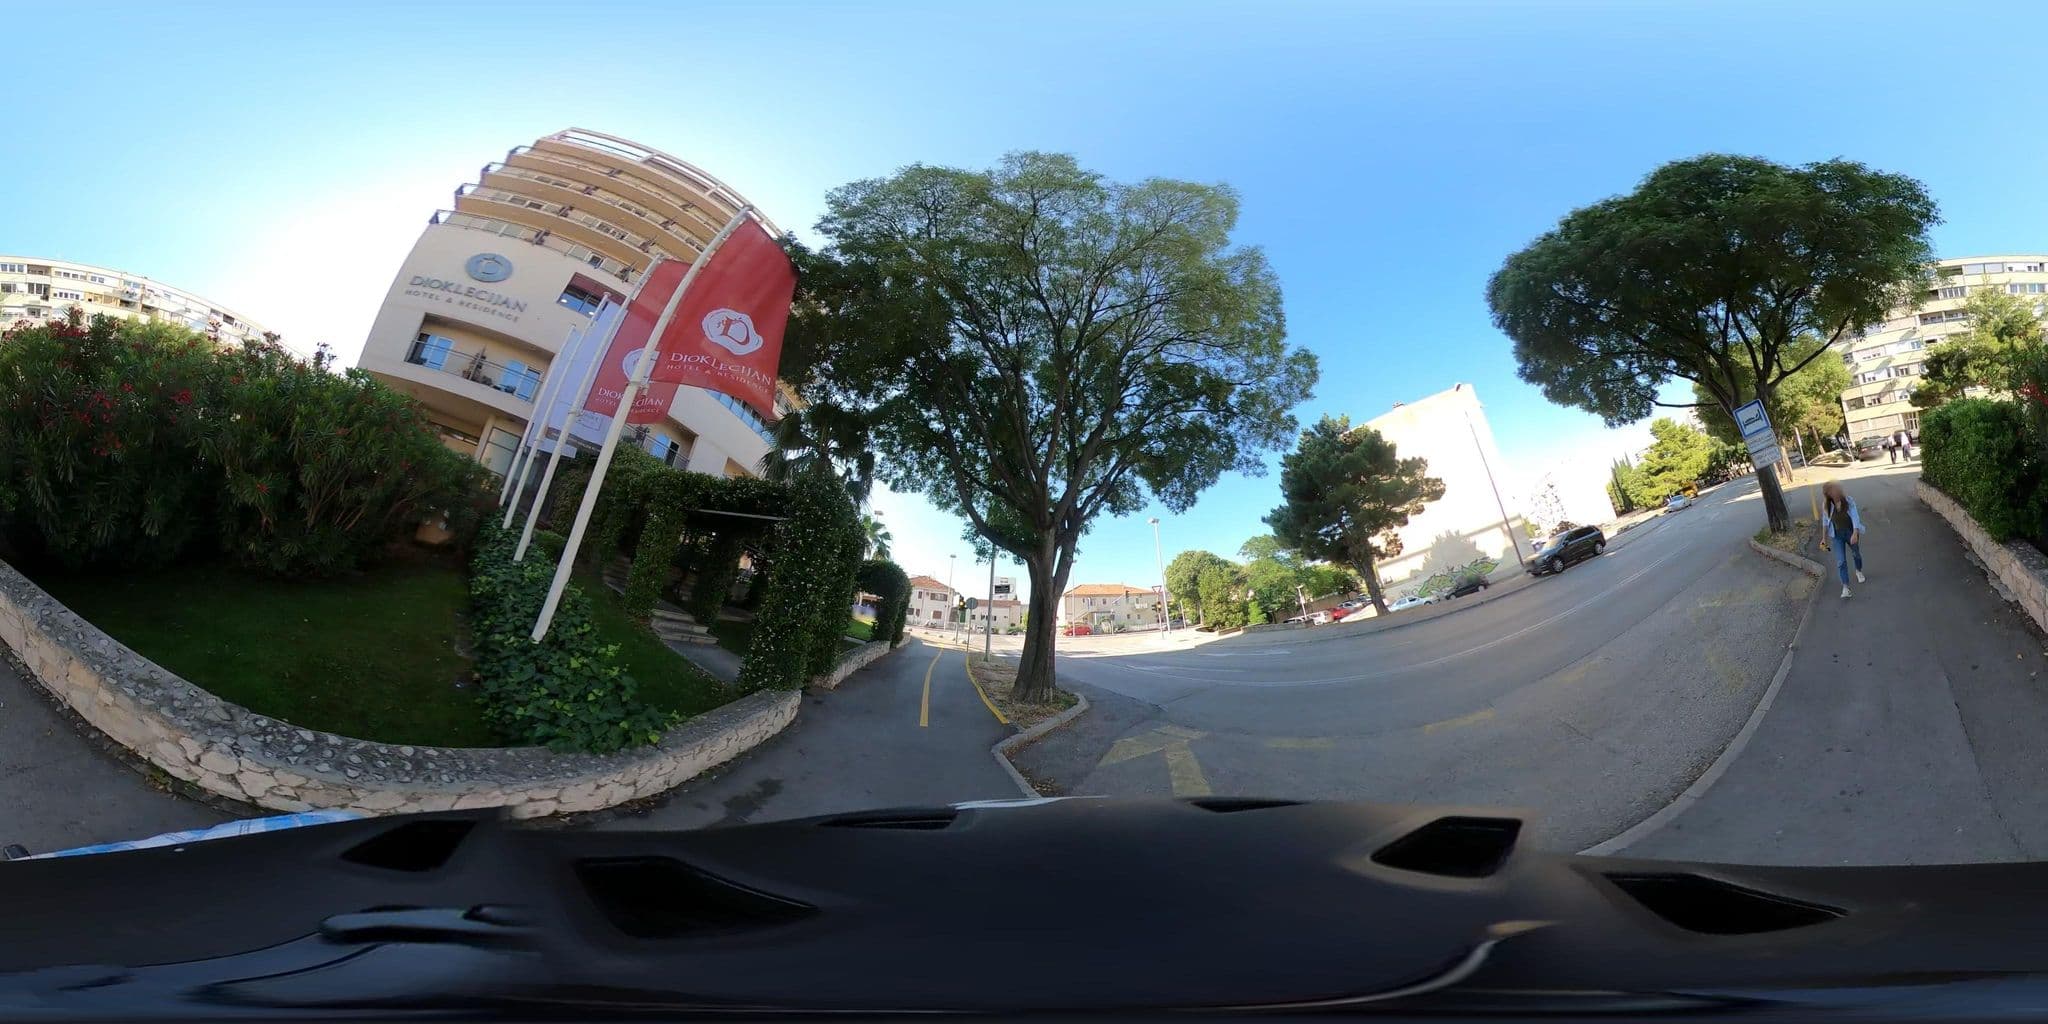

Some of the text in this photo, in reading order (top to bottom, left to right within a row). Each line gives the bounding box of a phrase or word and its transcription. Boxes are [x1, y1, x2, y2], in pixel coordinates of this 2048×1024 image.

[404, 288, 442, 301] HOTEL
[458, 300, 521, 323] RESIDENCE
[408, 275, 528, 313] DIOKLECIJAN
[666, 363, 700, 372] HOTEL
[670, 352, 772, 386] DIOKLECIJAN
